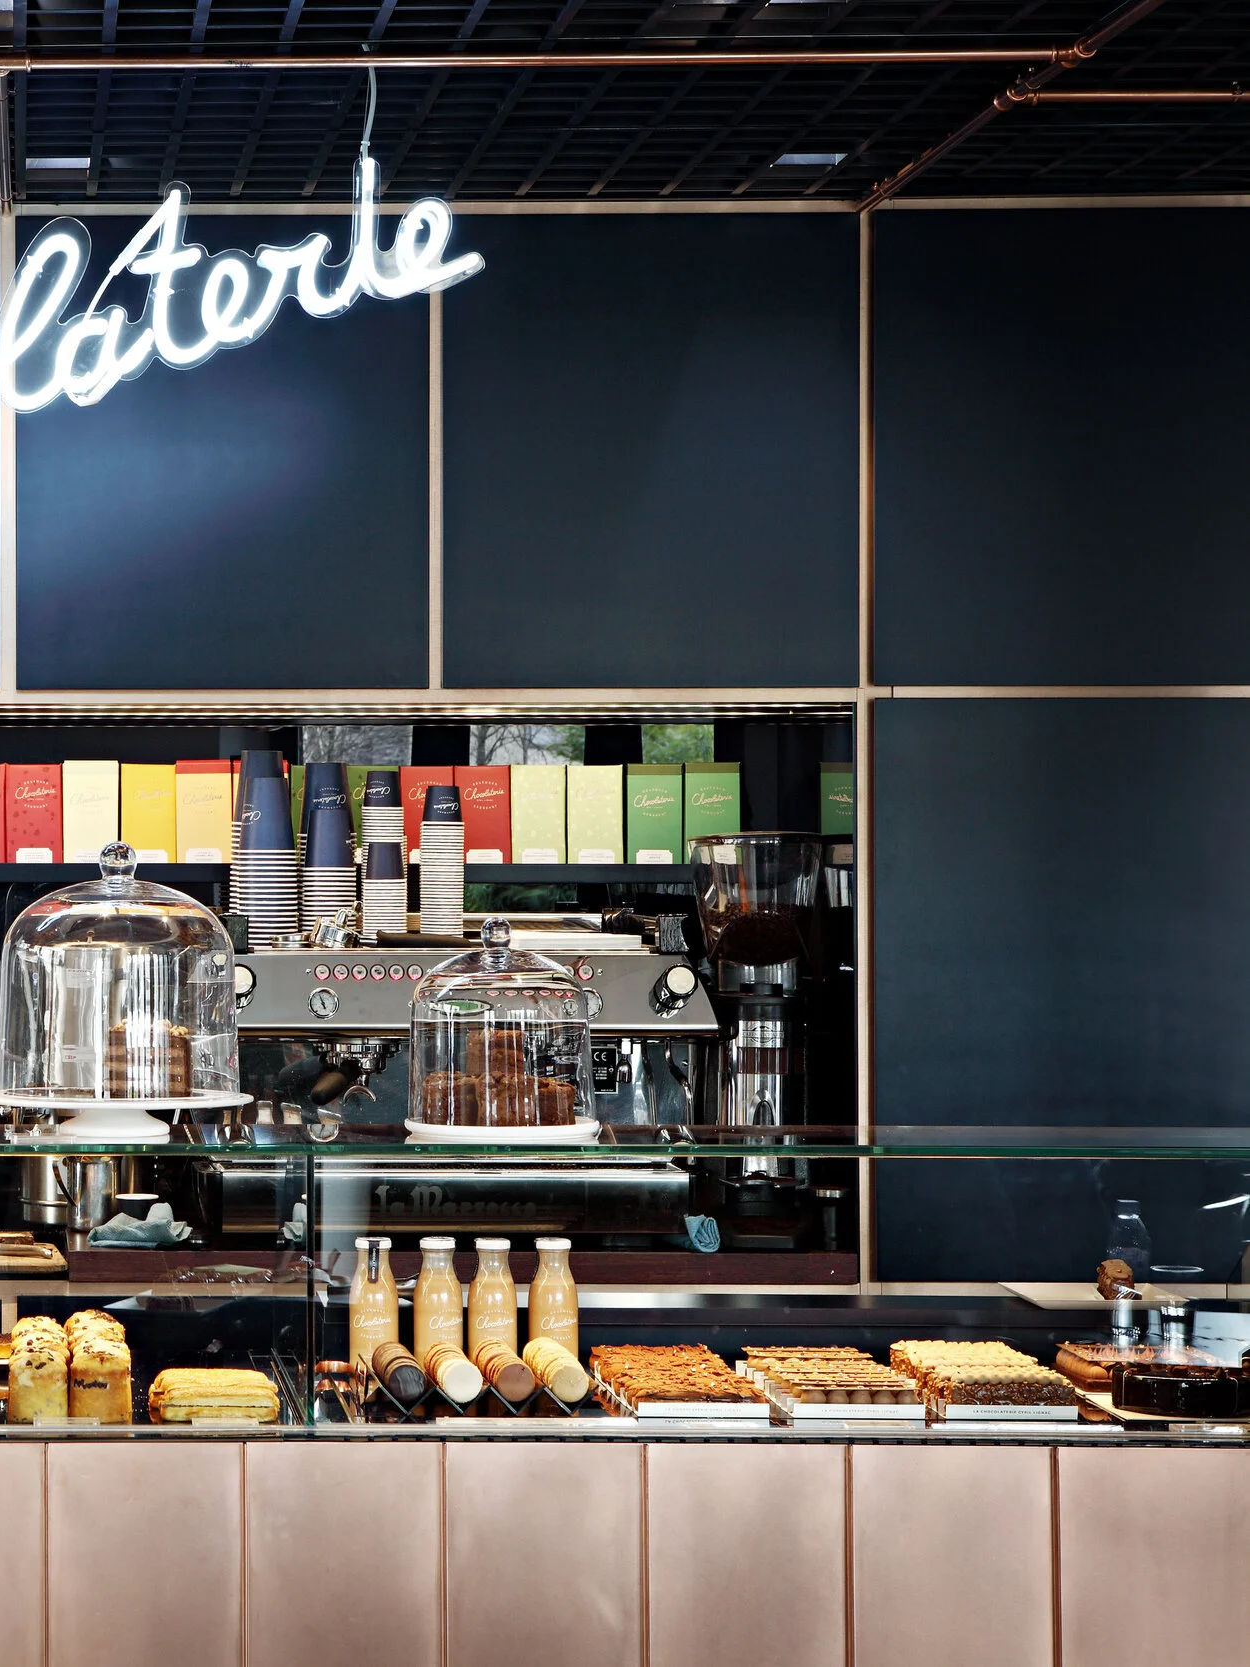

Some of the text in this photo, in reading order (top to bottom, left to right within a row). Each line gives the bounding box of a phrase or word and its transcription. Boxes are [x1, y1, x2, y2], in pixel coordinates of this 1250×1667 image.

[15, 786, 57, 799] Chocolaterie
[464, 787, 505, 800] Chocolaterie
[634, 794, 675, 808] Chocolaterie
[692, 793, 733, 806] Chocolaterie
[353, 1314, 391, 1328] Chocolaterie
